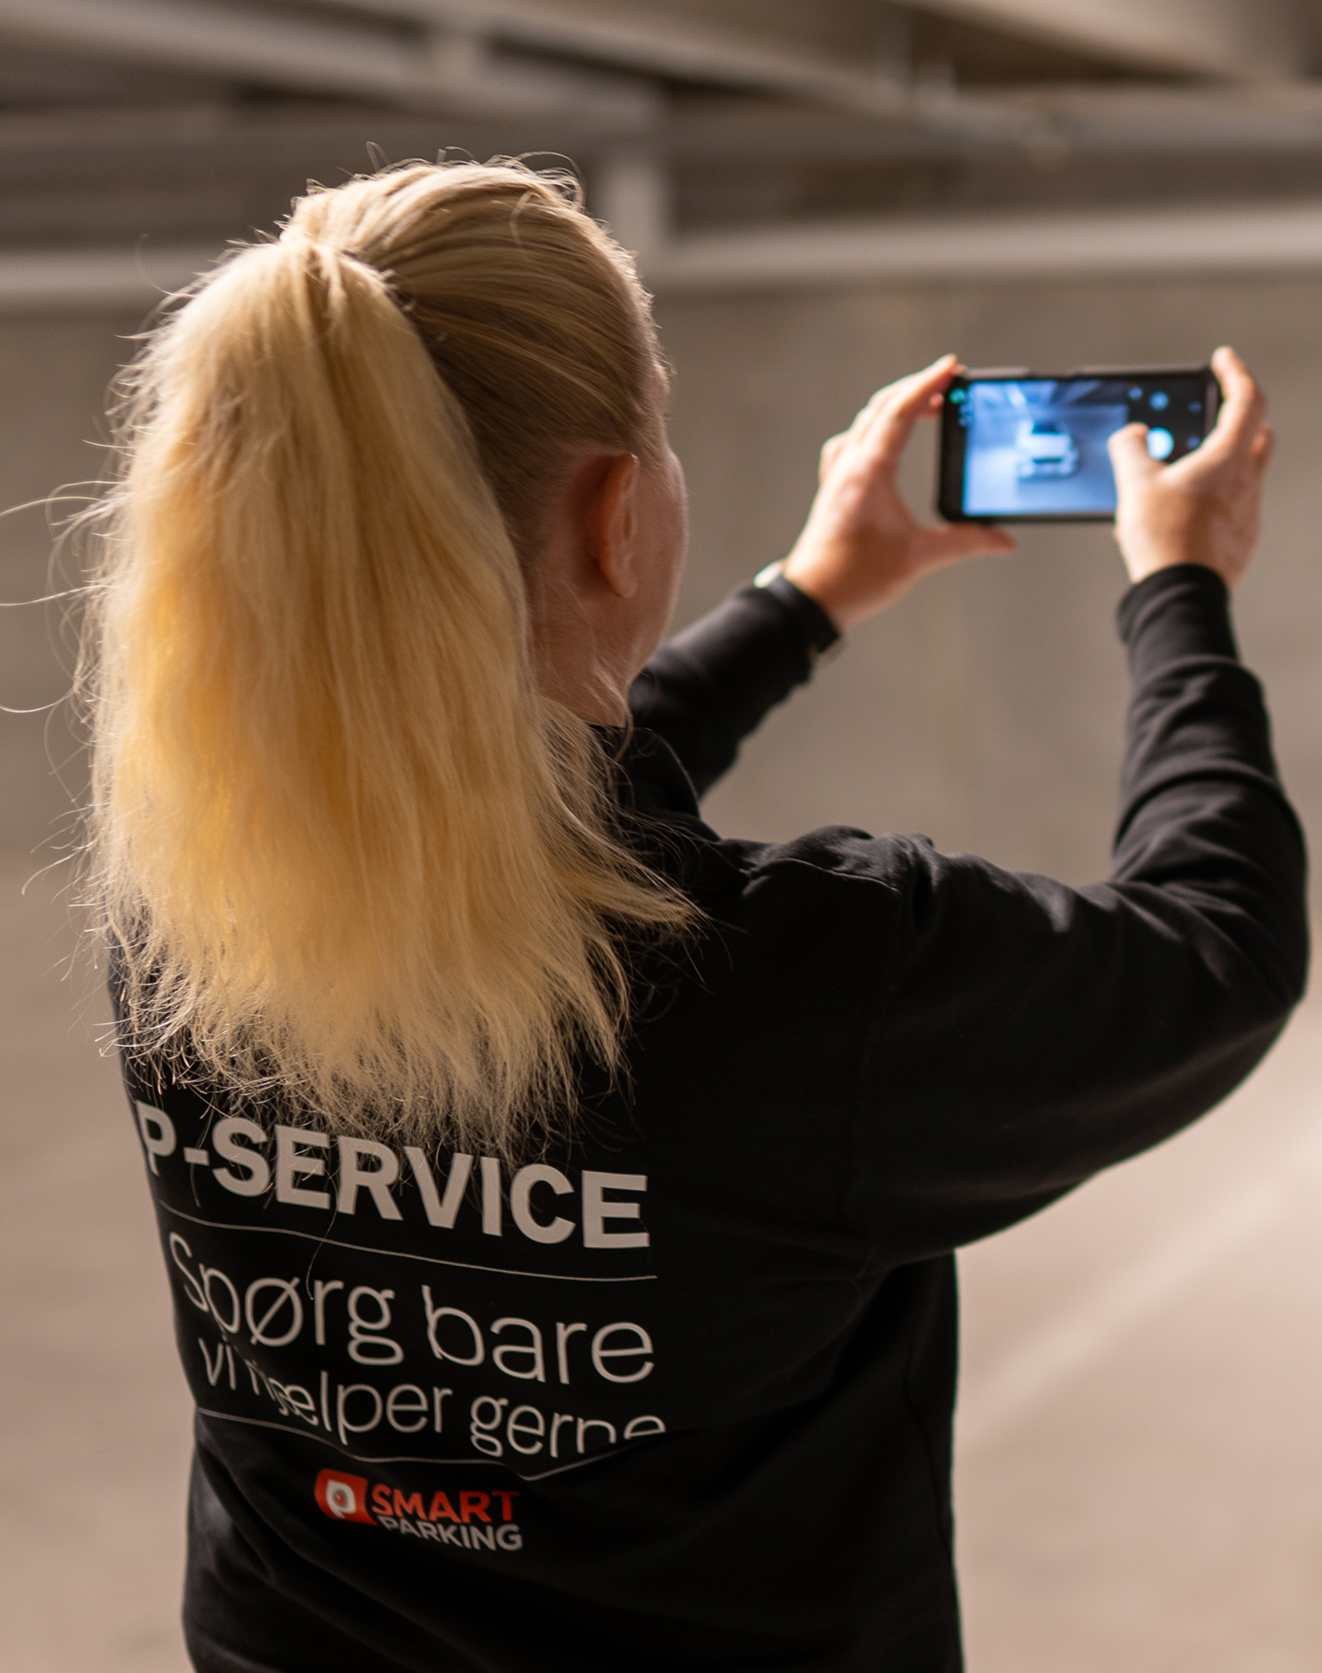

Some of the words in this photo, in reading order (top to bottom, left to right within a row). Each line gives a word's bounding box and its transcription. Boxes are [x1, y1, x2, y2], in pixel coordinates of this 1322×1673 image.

[135, 1099, 650, 1250] P-SERVICE
[168, 1231, 405, 1367] Spørg
[422, 1285, 654, 1385] bare
[197, 1335, 237, 1391] vi
[469, 1395, 667, 1459] gerne
[371, 1484, 521, 1524] SMART
[376, 1515, 523, 1551] PARKING
